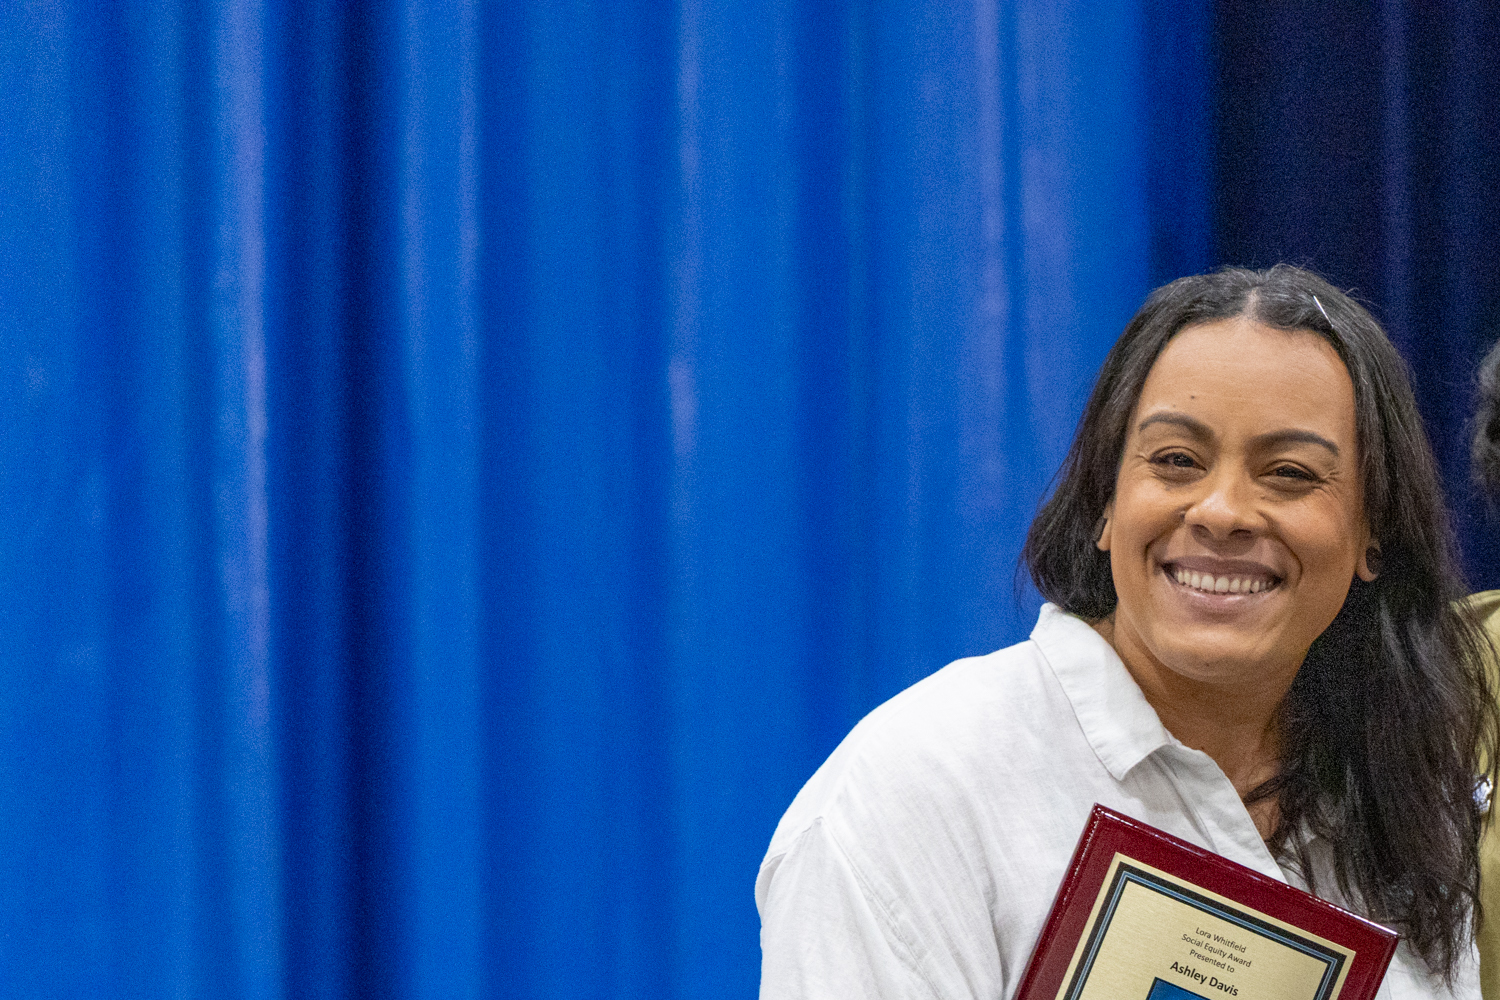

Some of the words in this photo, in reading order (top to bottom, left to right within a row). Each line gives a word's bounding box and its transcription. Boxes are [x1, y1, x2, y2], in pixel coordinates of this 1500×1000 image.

[1181, 934, 1203, 947] Social
[1204, 943, 1227, 959] Equity
[1227, 953, 1252, 968] Award
[1195, 927, 1212, 939] Lora
[1213, 934, 1247, 953] Whitfield
[1189, 949, 1226, 969] Presented
[1226, 964, 1235, 973] to
[1169, 961, 1208, 985] Ashley
[1208, 976, 1239, 997] Davis
